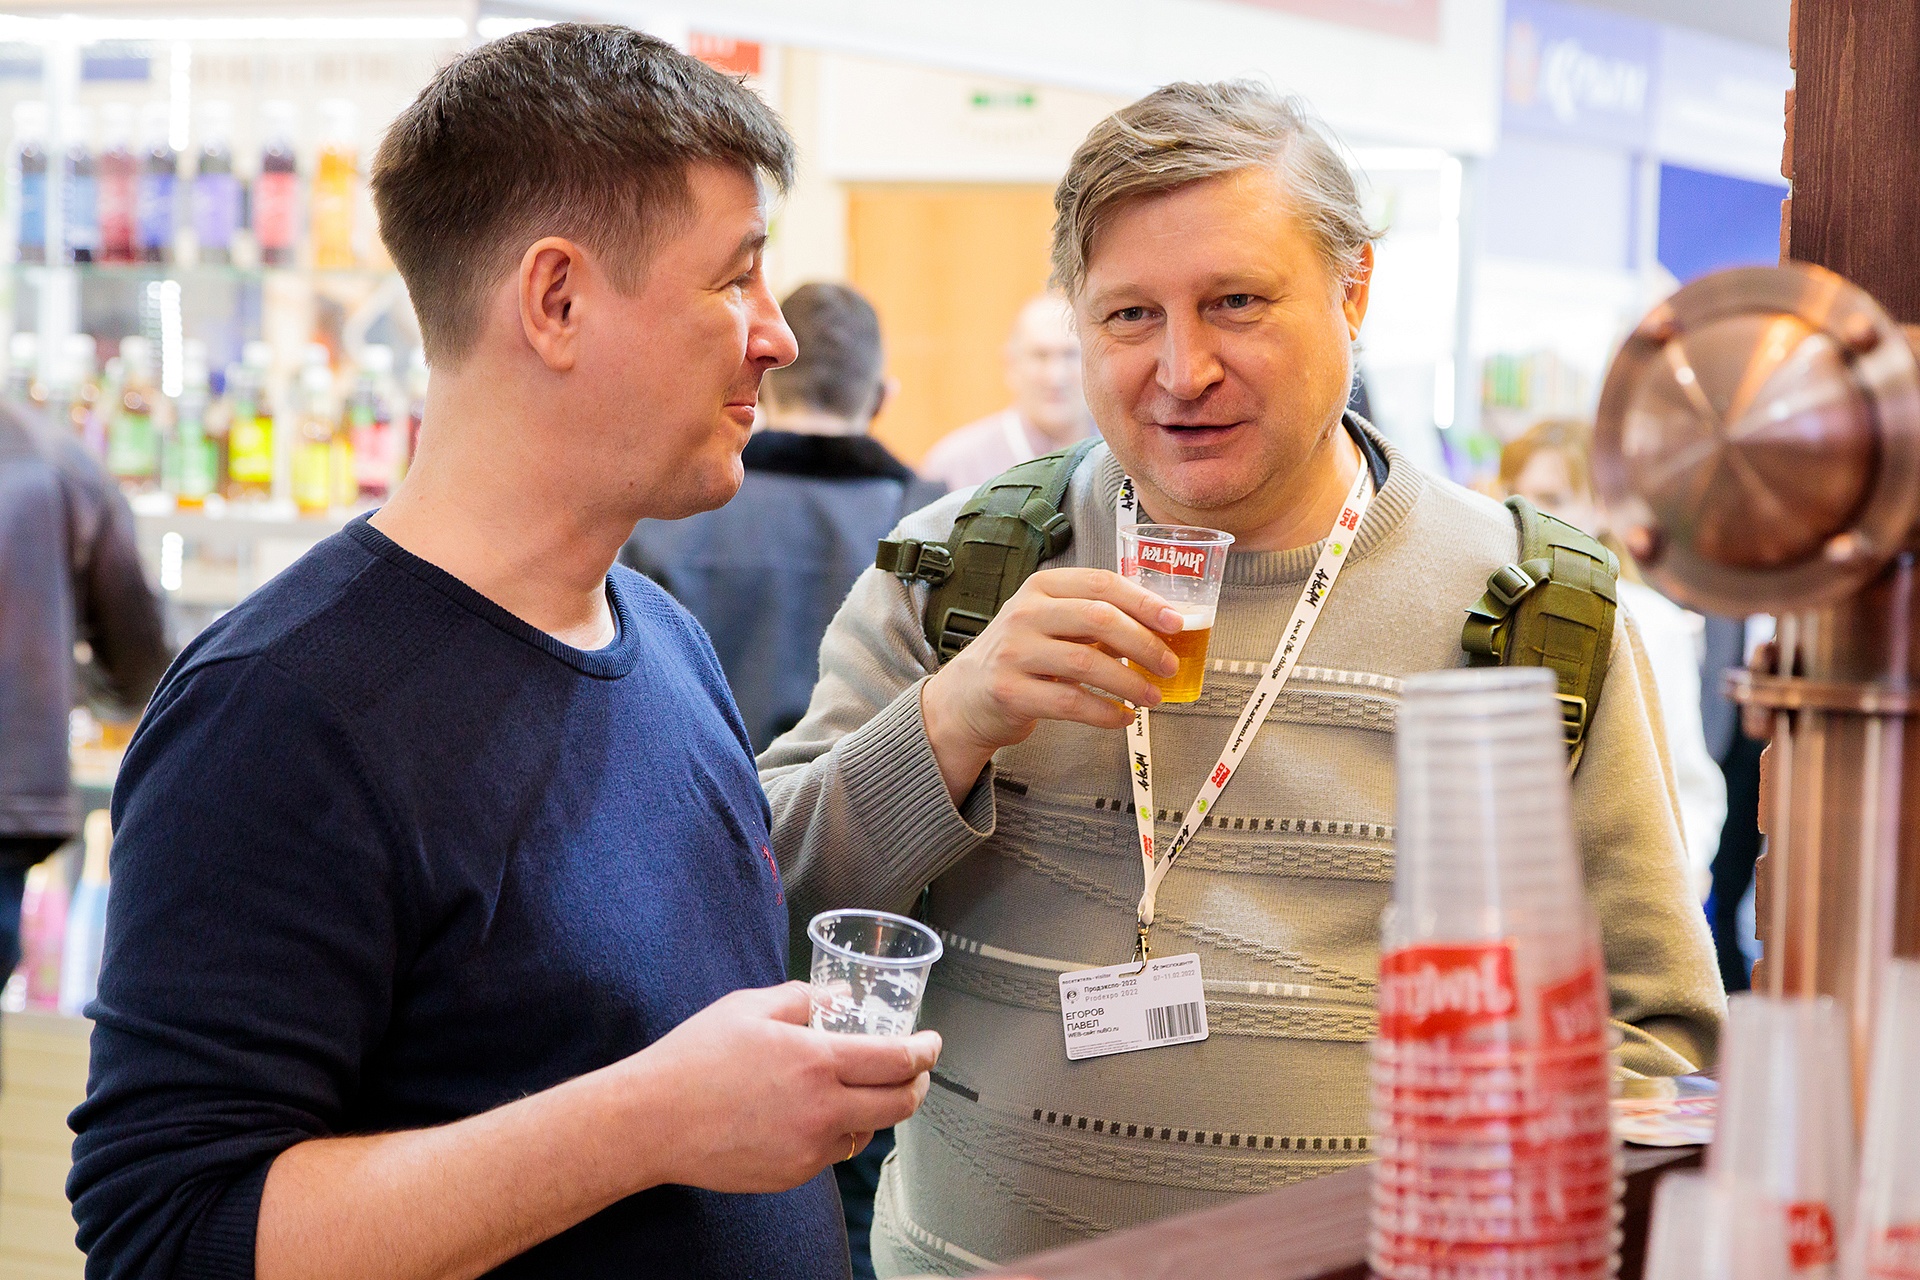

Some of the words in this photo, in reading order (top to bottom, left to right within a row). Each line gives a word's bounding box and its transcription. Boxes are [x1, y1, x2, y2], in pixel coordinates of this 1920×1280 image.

[1293, 619, 1305, 634] love
[1211, 762, 1225, 783] EXPO
[1216, 768, 1231, 788] PROD
[1085, 993, 1119, 1002] Prodexpo
[1121, 988, 1139, 997] 2022
[1066, 1007, 1105, 1020] ЕГОРОВ
[1067, 1019, 1100, 1031] ПАВЕЛ
